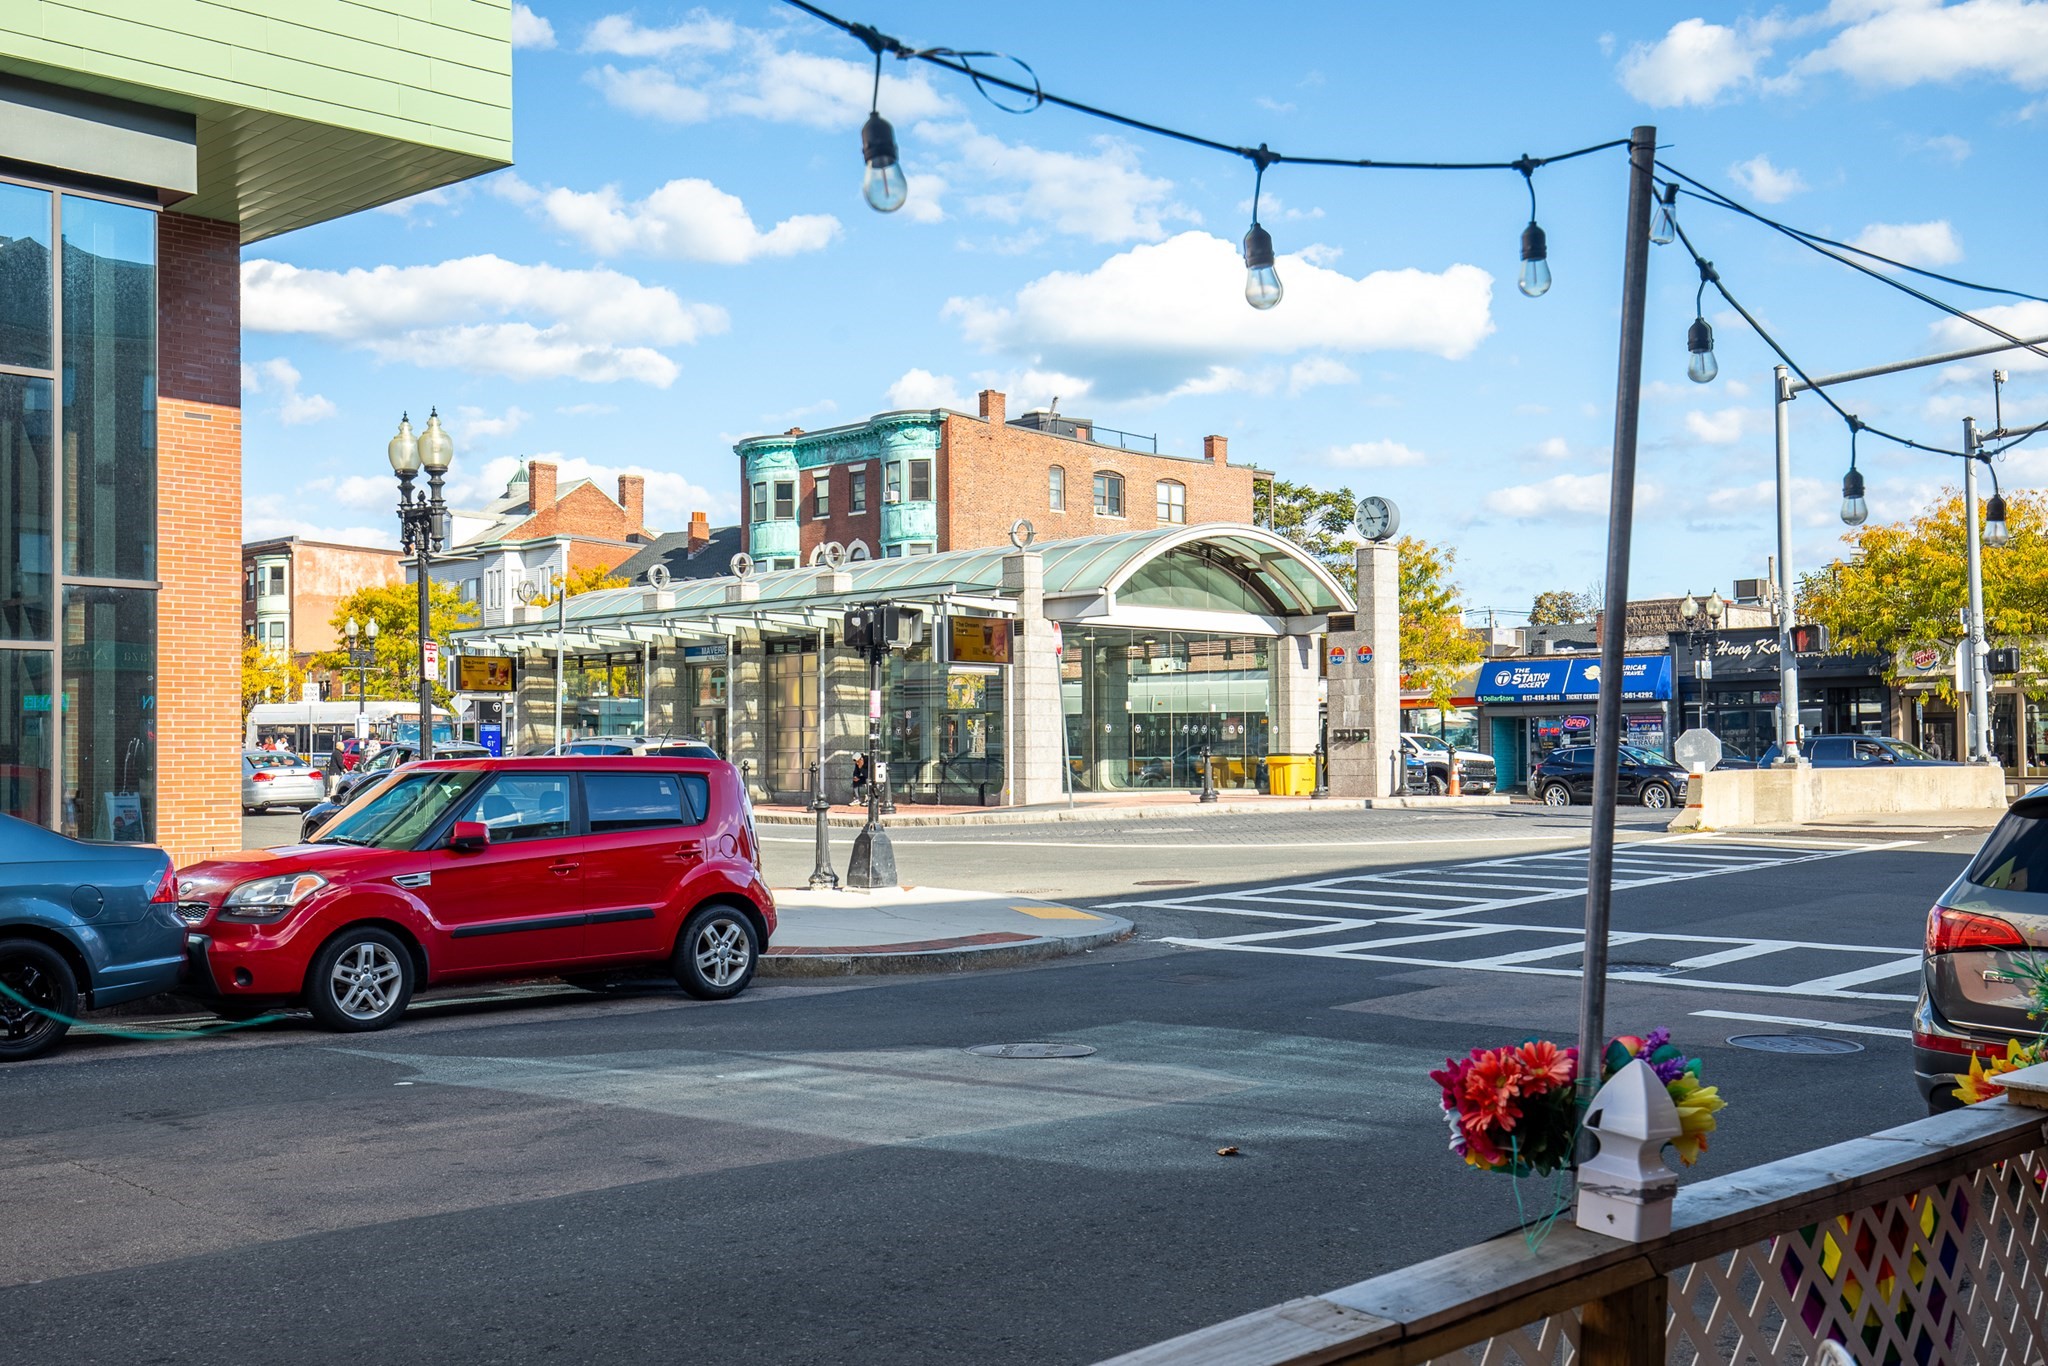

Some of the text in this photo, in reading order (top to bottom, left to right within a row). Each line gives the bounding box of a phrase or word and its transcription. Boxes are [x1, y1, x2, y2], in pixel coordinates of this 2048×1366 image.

[701, 644, 727, 655] MAVERIC
[1714, 640, 1752, 660] Hong
[1914, 652, 1936, 665] KING
[1511, 672, 1551, 685] STATION
[1518, 680, 1548, 689] GROCERY
[1566, 718, 1588, 728] OPEN
